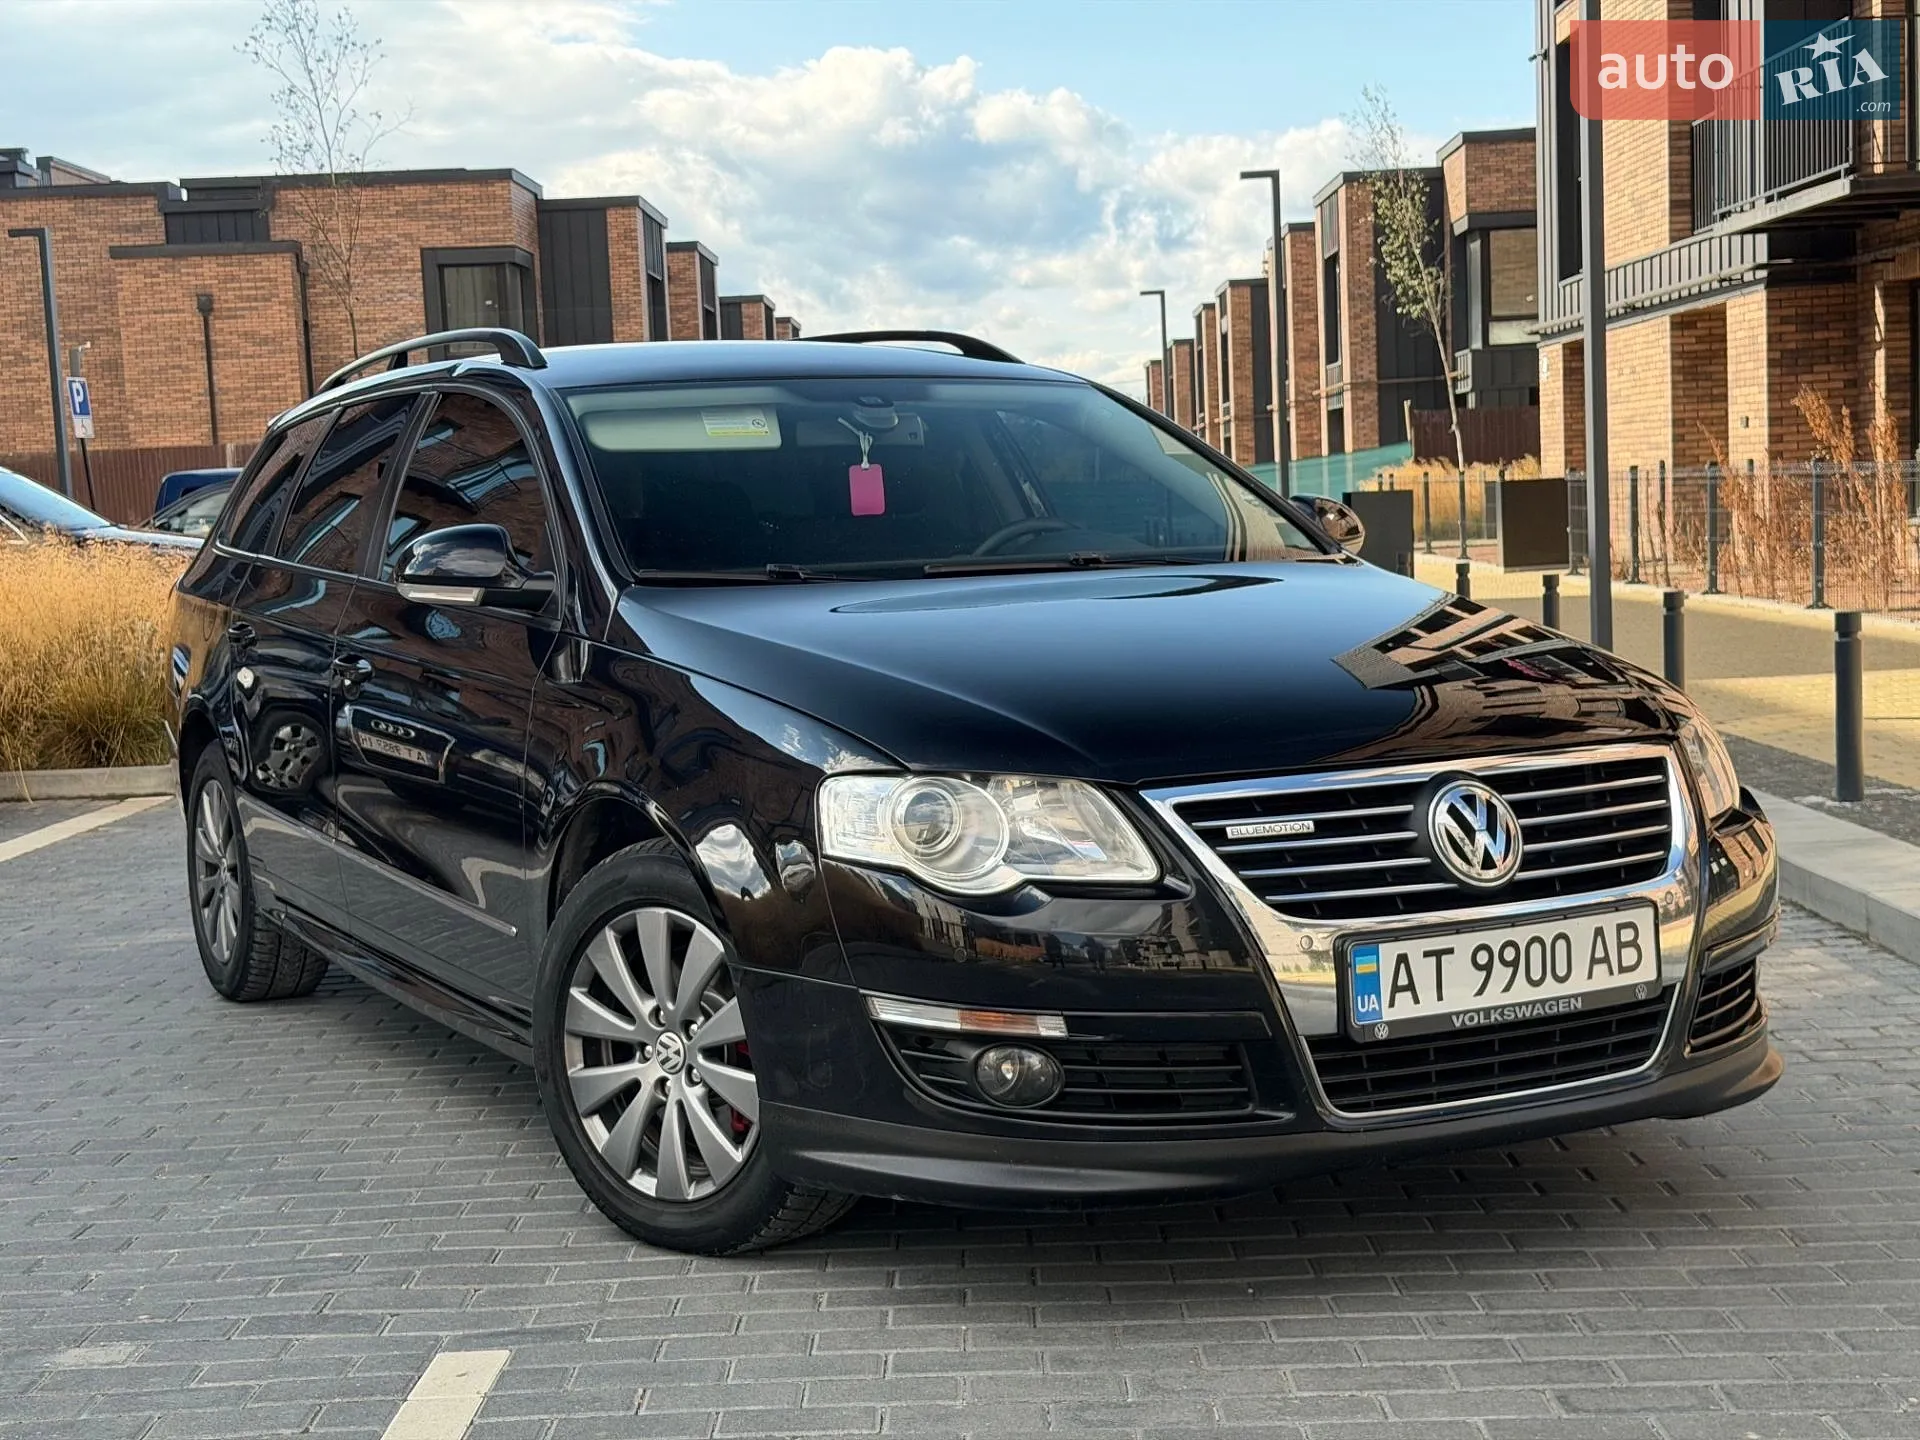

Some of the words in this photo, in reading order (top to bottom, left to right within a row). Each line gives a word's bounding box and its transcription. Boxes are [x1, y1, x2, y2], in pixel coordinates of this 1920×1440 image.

[71, 382, 84, 414] P
[1230, 822, 1311, 837] BLUEMOTION
[1388, 947, 1455, 1009] AT
[1470, 931, 1573, 998] 9900
[1586, 920, 1643, 980] AB
[1357, 994, 1380, 1013] UA
[1451, 996, 1583, 1028] VOLKSWAGEN
